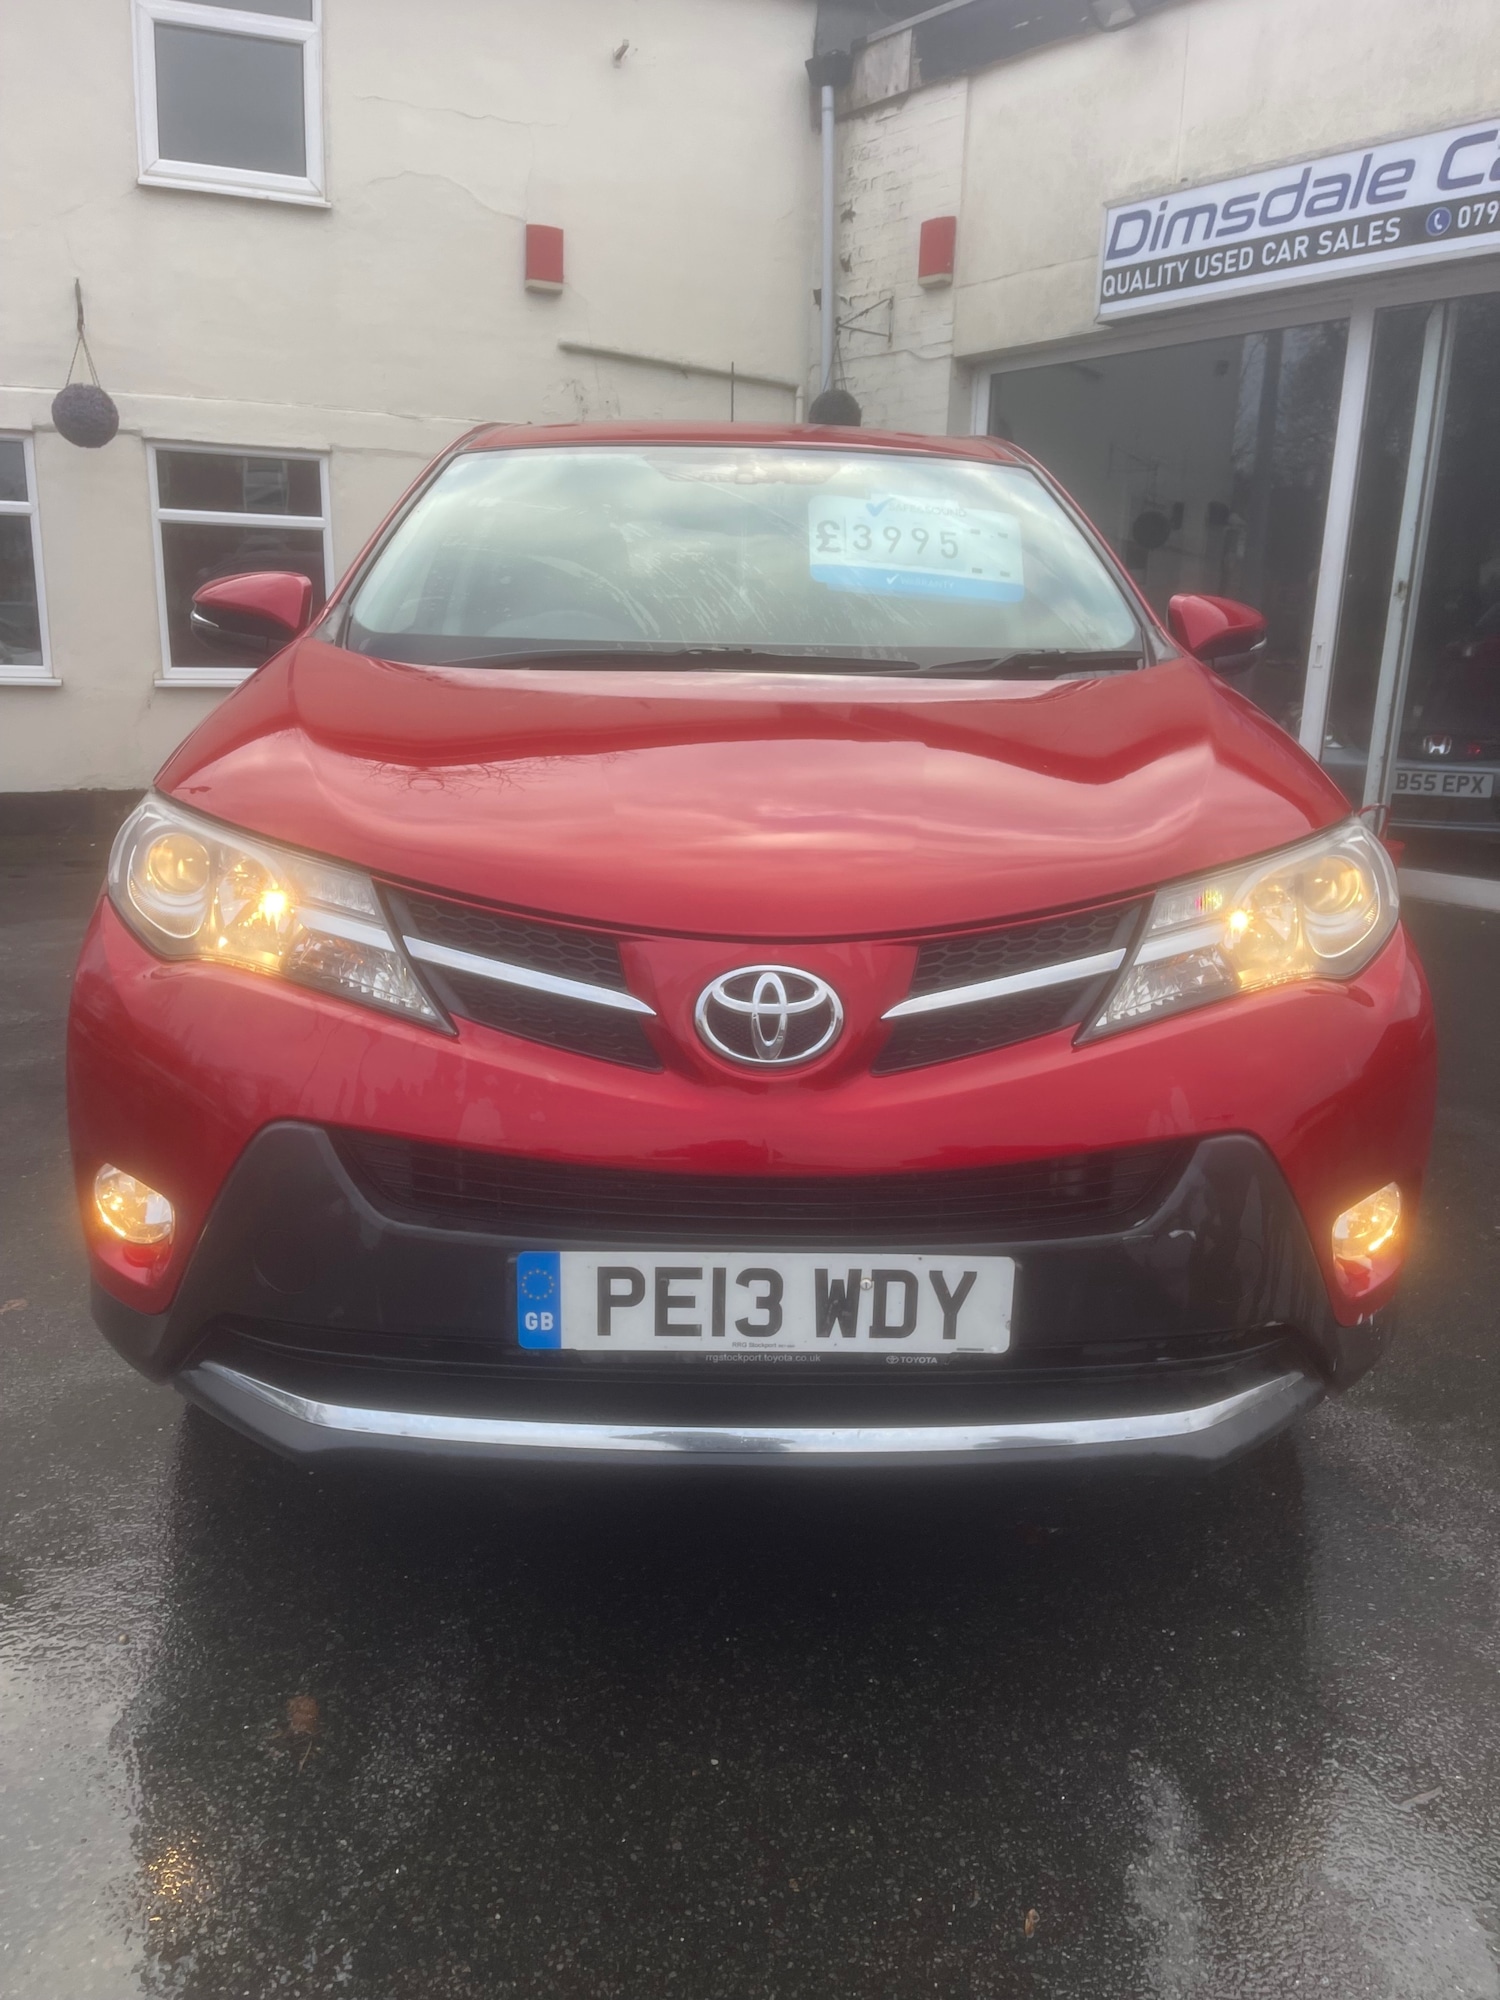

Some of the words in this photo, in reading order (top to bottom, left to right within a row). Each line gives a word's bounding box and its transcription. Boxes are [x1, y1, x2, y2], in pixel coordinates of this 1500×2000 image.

[1105, 153, 1416, 260] Dimsdale
[1435, 129, 1500, 190] C
[1102, 259, 1189, 298] QUALITY
[1194, 246, 1253, 279] USED
[1261, 235, 1307, 266] CAR
[1316, 217, 1401, 256] SALES
[1395, 772, 1437, 792] B55
[1442, 774, 1485, 794] EPX
[597, 1266, 784, 1337] PE13
[814, 1268, 978, 1340] WDY
[524, 1311, 554, 1331] GB
[748, 1341, 777, 1350] Stockport
[705, 1353, 821, 1363] rrgstockport.toyota.co.uk
[900, 1356, 938, 1365] TOYOTA
